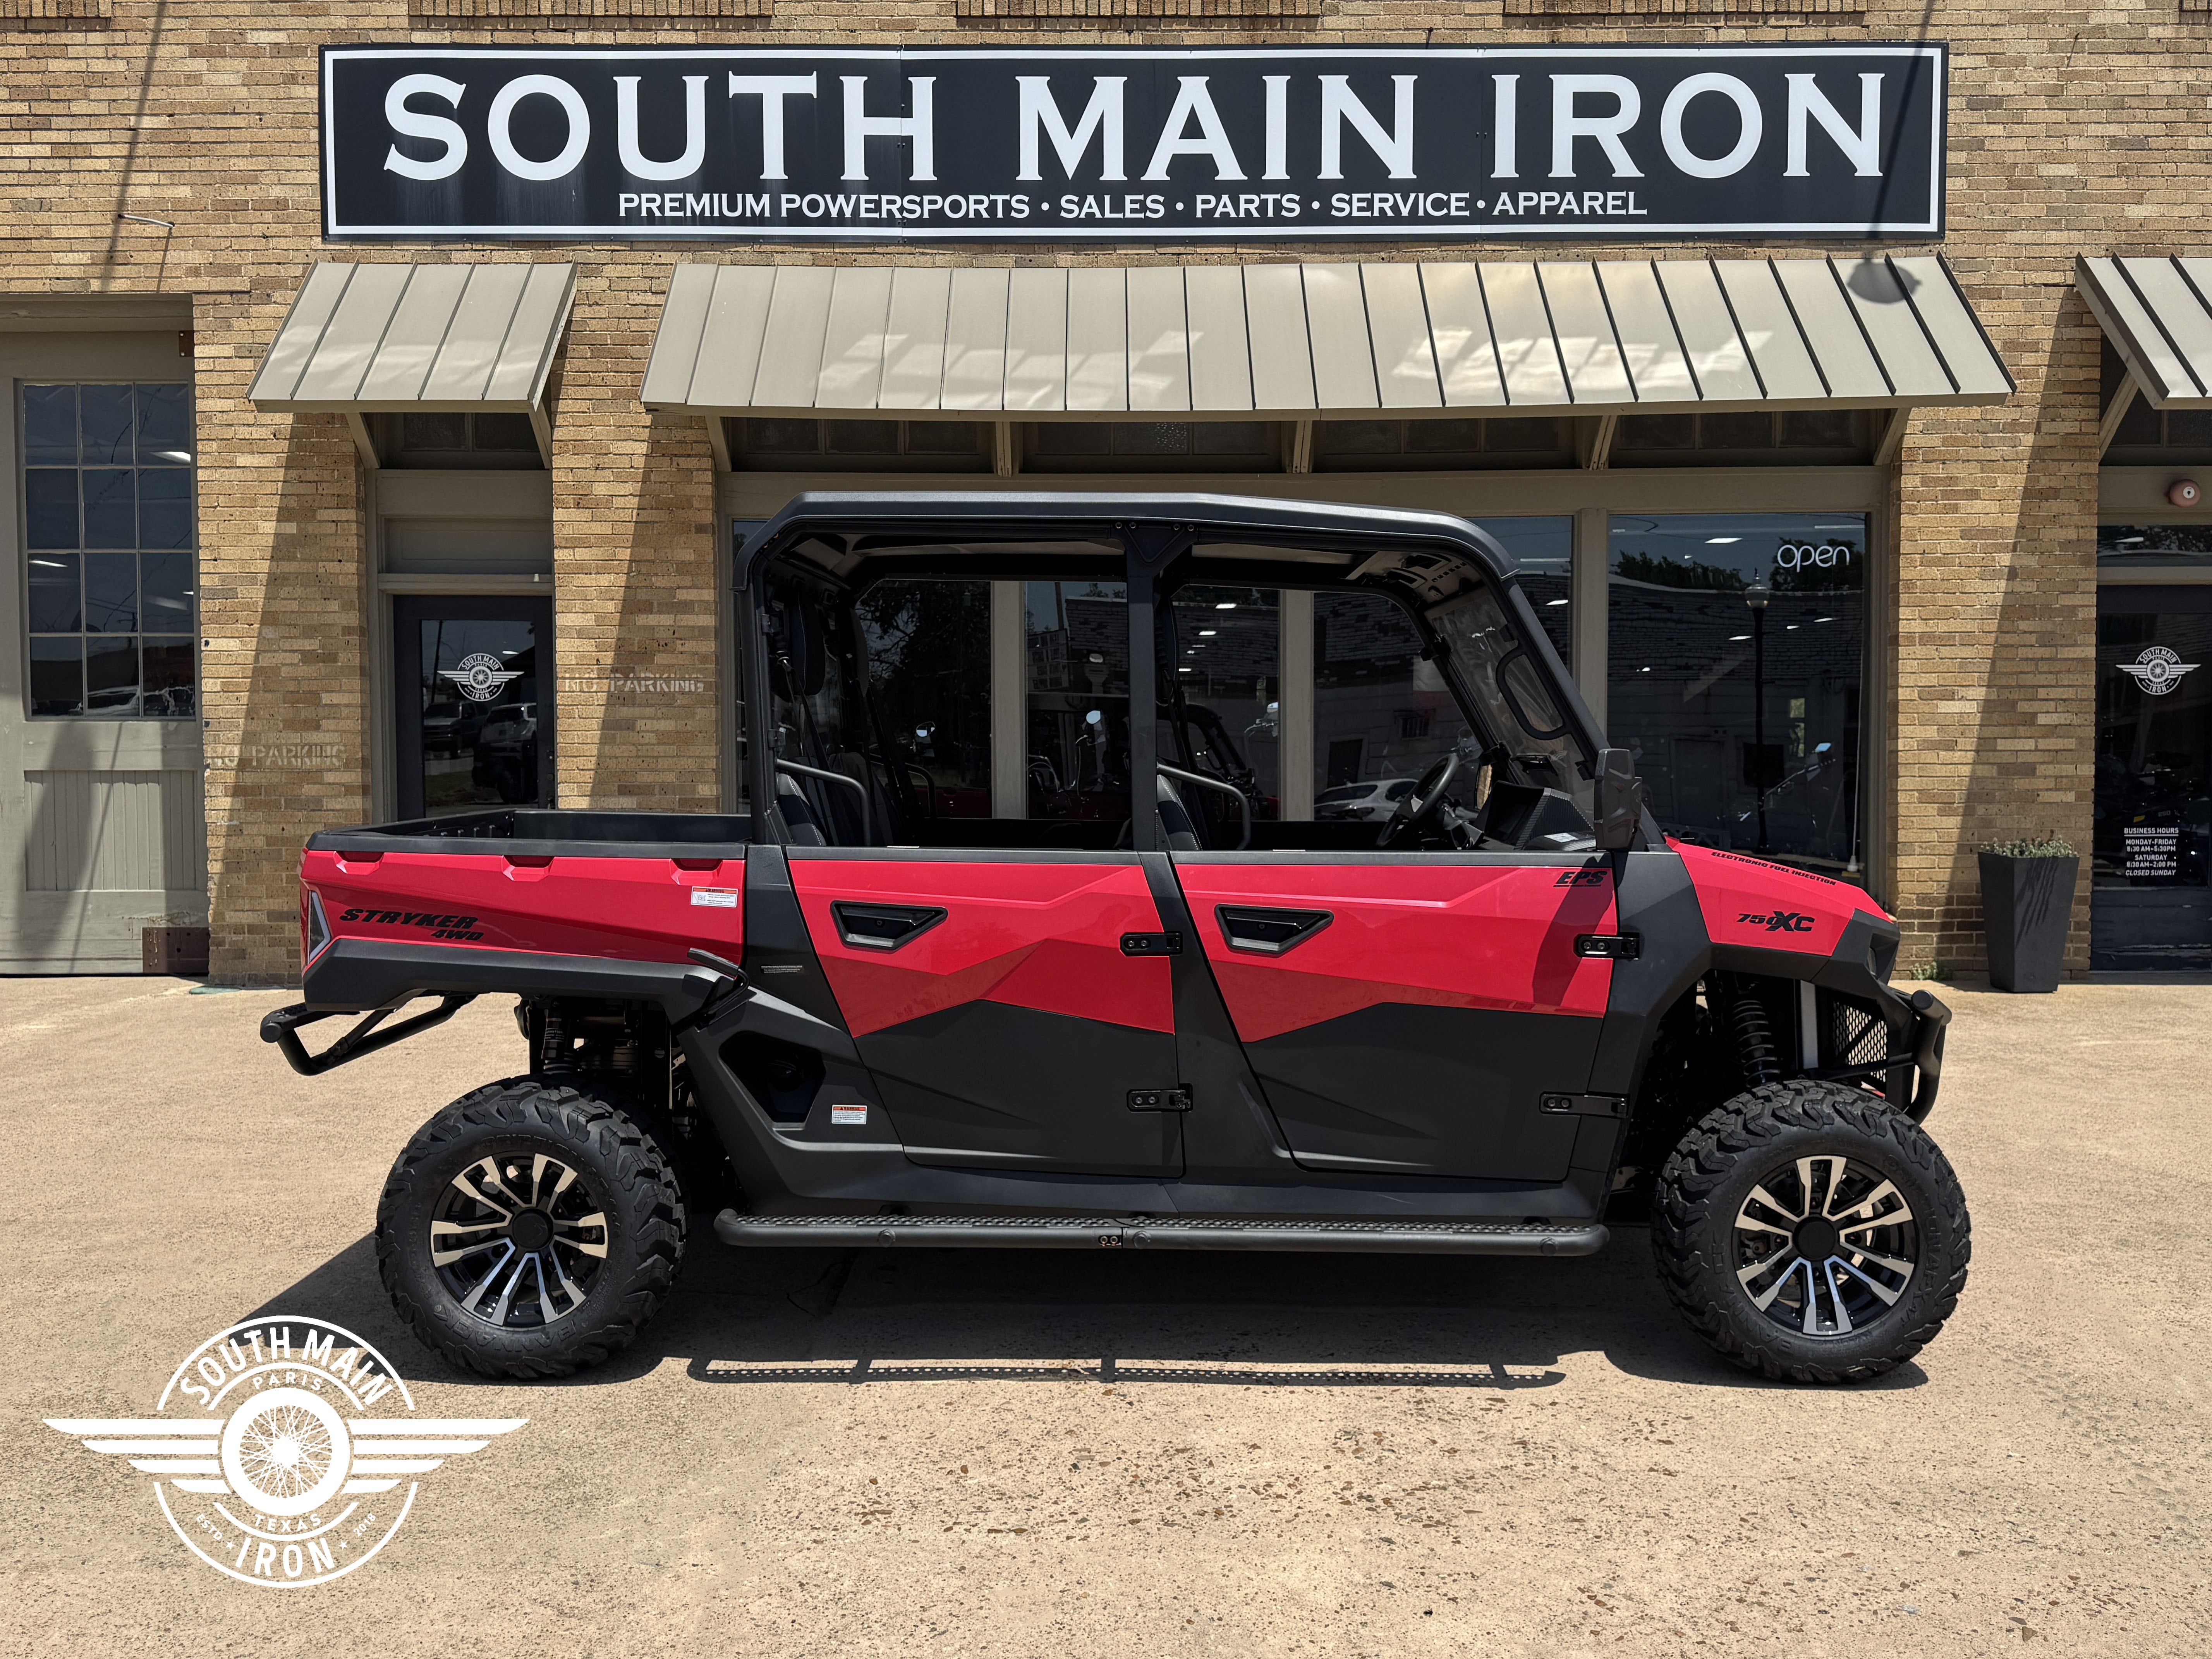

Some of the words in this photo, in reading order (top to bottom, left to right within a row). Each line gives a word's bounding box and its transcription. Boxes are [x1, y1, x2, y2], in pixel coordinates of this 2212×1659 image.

[384, 71, 938, 181] SOUTH
[1015, 73, 1418, 180] MAIN
[1490, 72, 1885, 179] IRON
[619, 193, 771, 217] PREMIUM
[780, 194, 1030, 219] POWERSPORTS
[1060, 194, 1165, 219] SALES
[1196, 193, 1300, 218] PARTS
[1331, 192, 1470, 217] SERVICE
[1492, 191, 1647, 215] APPAREL
[1778, 544, 1850, 572] open
[462, 655, 481, 670] SOUTH
[483, 656, 500, 670] MAIN
[2140, 648, 2159, 663] SOUTH
[2161, 649, 2177, 663] MAIN
[565, 673, 597, 691] NO
[610, 672, 704, 693] PARKING
[252, 745, 345, 766] PARKING
[1556, 871, 1607, 884] EPS
[1711, 852, 1768, 867] ELECTRONIC
[1769, 865, 1789, 873] FUEL
[1791, 870, 1836, 886] INJECTION
[339, 908, 478, 929] STRYKER
[431, 930, 484, 941] 4WD
